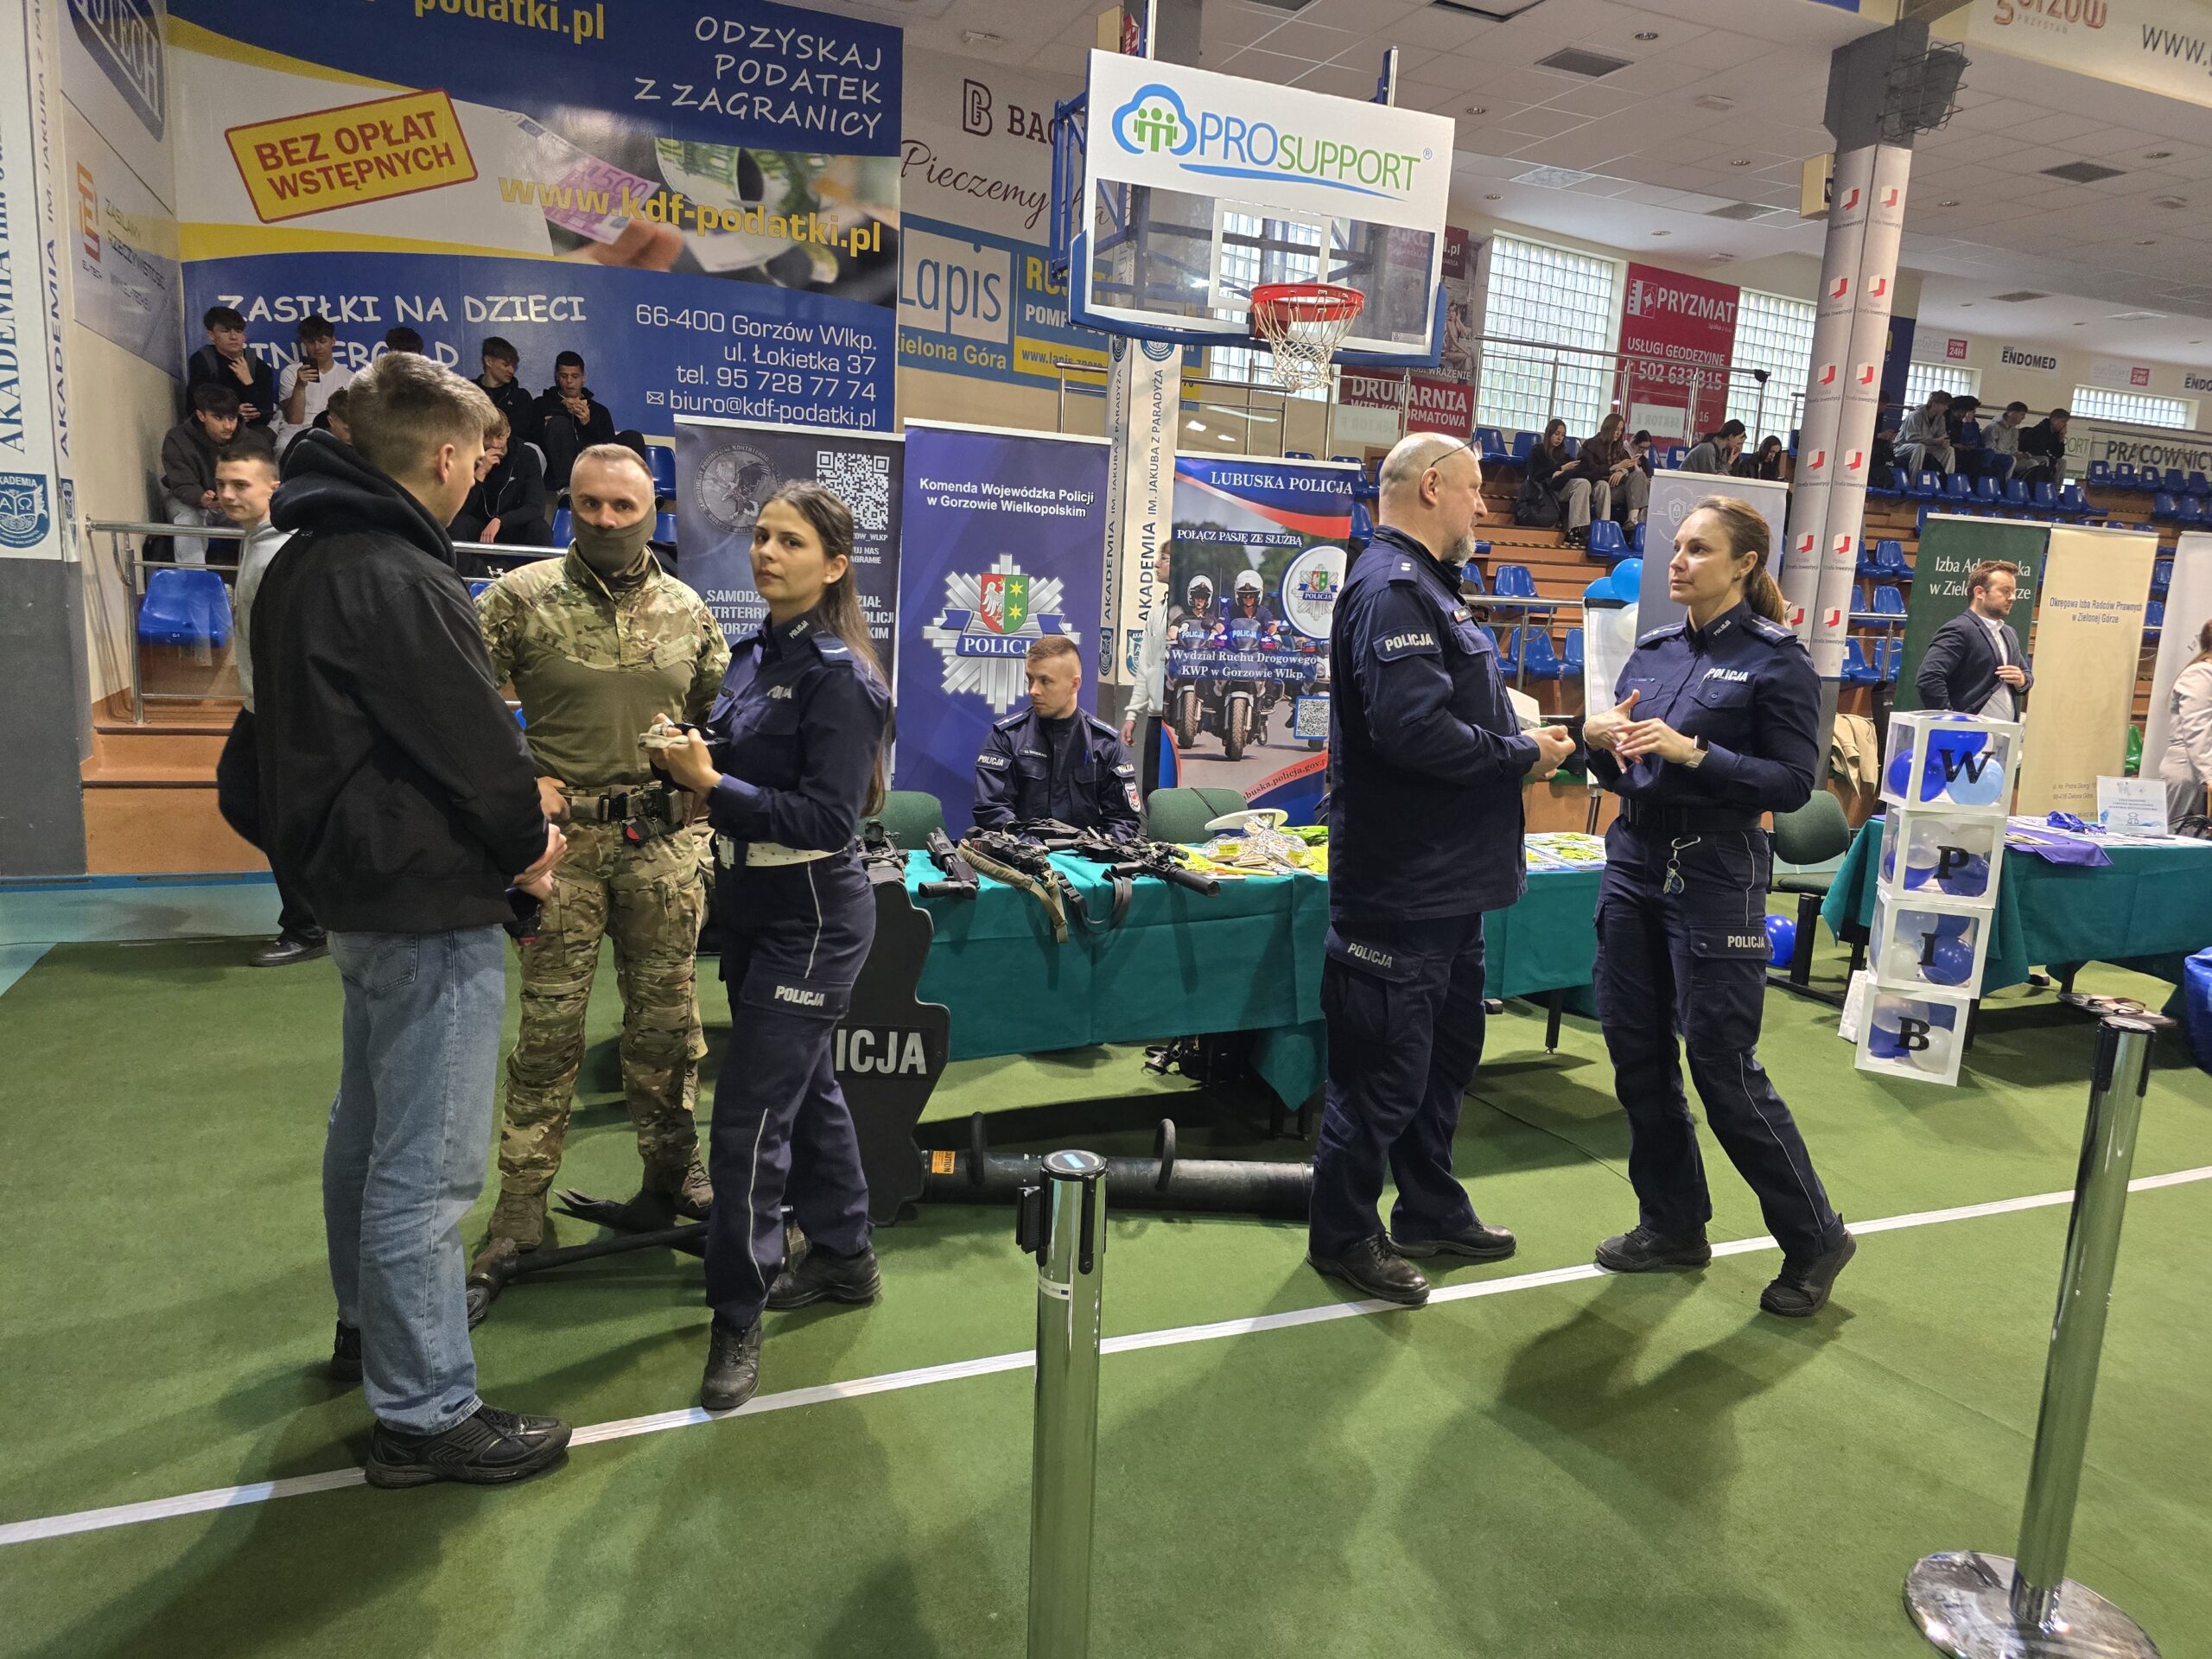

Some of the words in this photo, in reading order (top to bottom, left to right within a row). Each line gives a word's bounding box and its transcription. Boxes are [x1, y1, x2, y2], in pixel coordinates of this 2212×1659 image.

[695, 16, 881, 71] ODZYSKAJ
[715, 54, 881, 105] PODATEK
[634, 77, 661, 100] Z
[671, 83, 882, 139] ZAGRANICY
[254, 132, 330, 172] BEZ
[334, 111, 438, 156] OPŁAT
[267, 143, 456, 200] WSTĘPNYCH
[901, 140, 1051, 229] Pieczemy
[499, 176, 880, 257] www.kdf-podatki.pl
[218, 296, 381, 323] ZASIŁKI
[395, 296, 448, 323] NA
[464, 296, 588, 323] DZIECI
[1656, 287, 1736, 323] PRYZMAT
[636, 303, 725, 333] 66-400
[732, 315, 813, 343] Gorzów
[819, 324, 877, 353] Wlkp.
[724, 342, 747, 363] ul.
[753, 344, 840, 372] Łokietka
[847, 354, 876, 376] 37
[897, 332, 957, 362] ielona
[963, 343, 1007, 370] Góra
[1628, 336, 1664, 355] USŁUGI
[1666, 343, 1726, 367] GEODEZYJNE
[2001, 350, 2056, 370] ENDOMED
[677, 365, 709, 385] tel.
[716, 366, 748, 389] 95
[755, 371, 803, 395] 728
[810, 376, 839, 398] 77
[847, 380, 876, 402] 74
[1639, 359, 1664, 384] 502
[670, 389, 876, 430] biuro@kdf-podatki.pl
[1151, 369, 1164, 434] PARADYŻA
[0, 476, 38, 487] KADEMIA
[1148, 446, 1160, 494] JAKUBA
[1211, 471, 1285, 490] LUBUSKA
[1288, 477, 1354, 495] POLICJA
[919, 478, 978, 494] Komenda
[981, 482, 1056, 501] Wojewódzka
[1058, 489, 1095, 505] Policji
[927, 497, 938, 505] w
[940, 495, 997, 512] Gorzowie
[1001, 499, 1087, 518] Wielkopolskim
[1177, 529, 1217, 543] POŁĄCZ
[1219, 531, 1249, 545] PASJĘ
[1250, 533, 1263, 543] ZE
[1265, 533, 1303, 547] SŁUŻBĄ
[1104, 520, 1116, 620] AKADEMIA
[1139, 521, 1156, 621] AKADEMIA
[1936, 556, 1960, 572] Izba
[706, 589, 765, 603] SAMODZ
[1929, 582, 1942, 595] w
[788, 620, 810, 639] POLICJA
[862, 611, 894, 624] OLICJI
[1713, 620, 1732, 637] POLICJA
[963, 637, 1030, 655] POLICJ
[1232, 630, 1257, 639] POLICJA
[1384, 633, 1434, 652] POLICJA
[1172, 650, 1216, 663] Wydział
[1218, 651, 1253, 662] Ruchu
[1257, 652, 1317, 664] Drogowego
[1181, 665, 1208, 677] KWP
[1222, 666, 1273, 678] Gorzowie
[1275, 668, 1306, 681] Wlkp.
[1707, 668, 1750, 682] POLICJA
[977, 754, 1004, 766] POLICJA
[1937, 748, 1996, 785] W
[1933, 845, 1970, 880] P
[1727, 935, 1765, 948] POLICJA
[1918, 932, 1940, 967] I
[1347, 942, 1392, 969] POLICJA
[774, 985, 825, 1007] POLICJA
[1895, 1016, 1930, 1051] B
